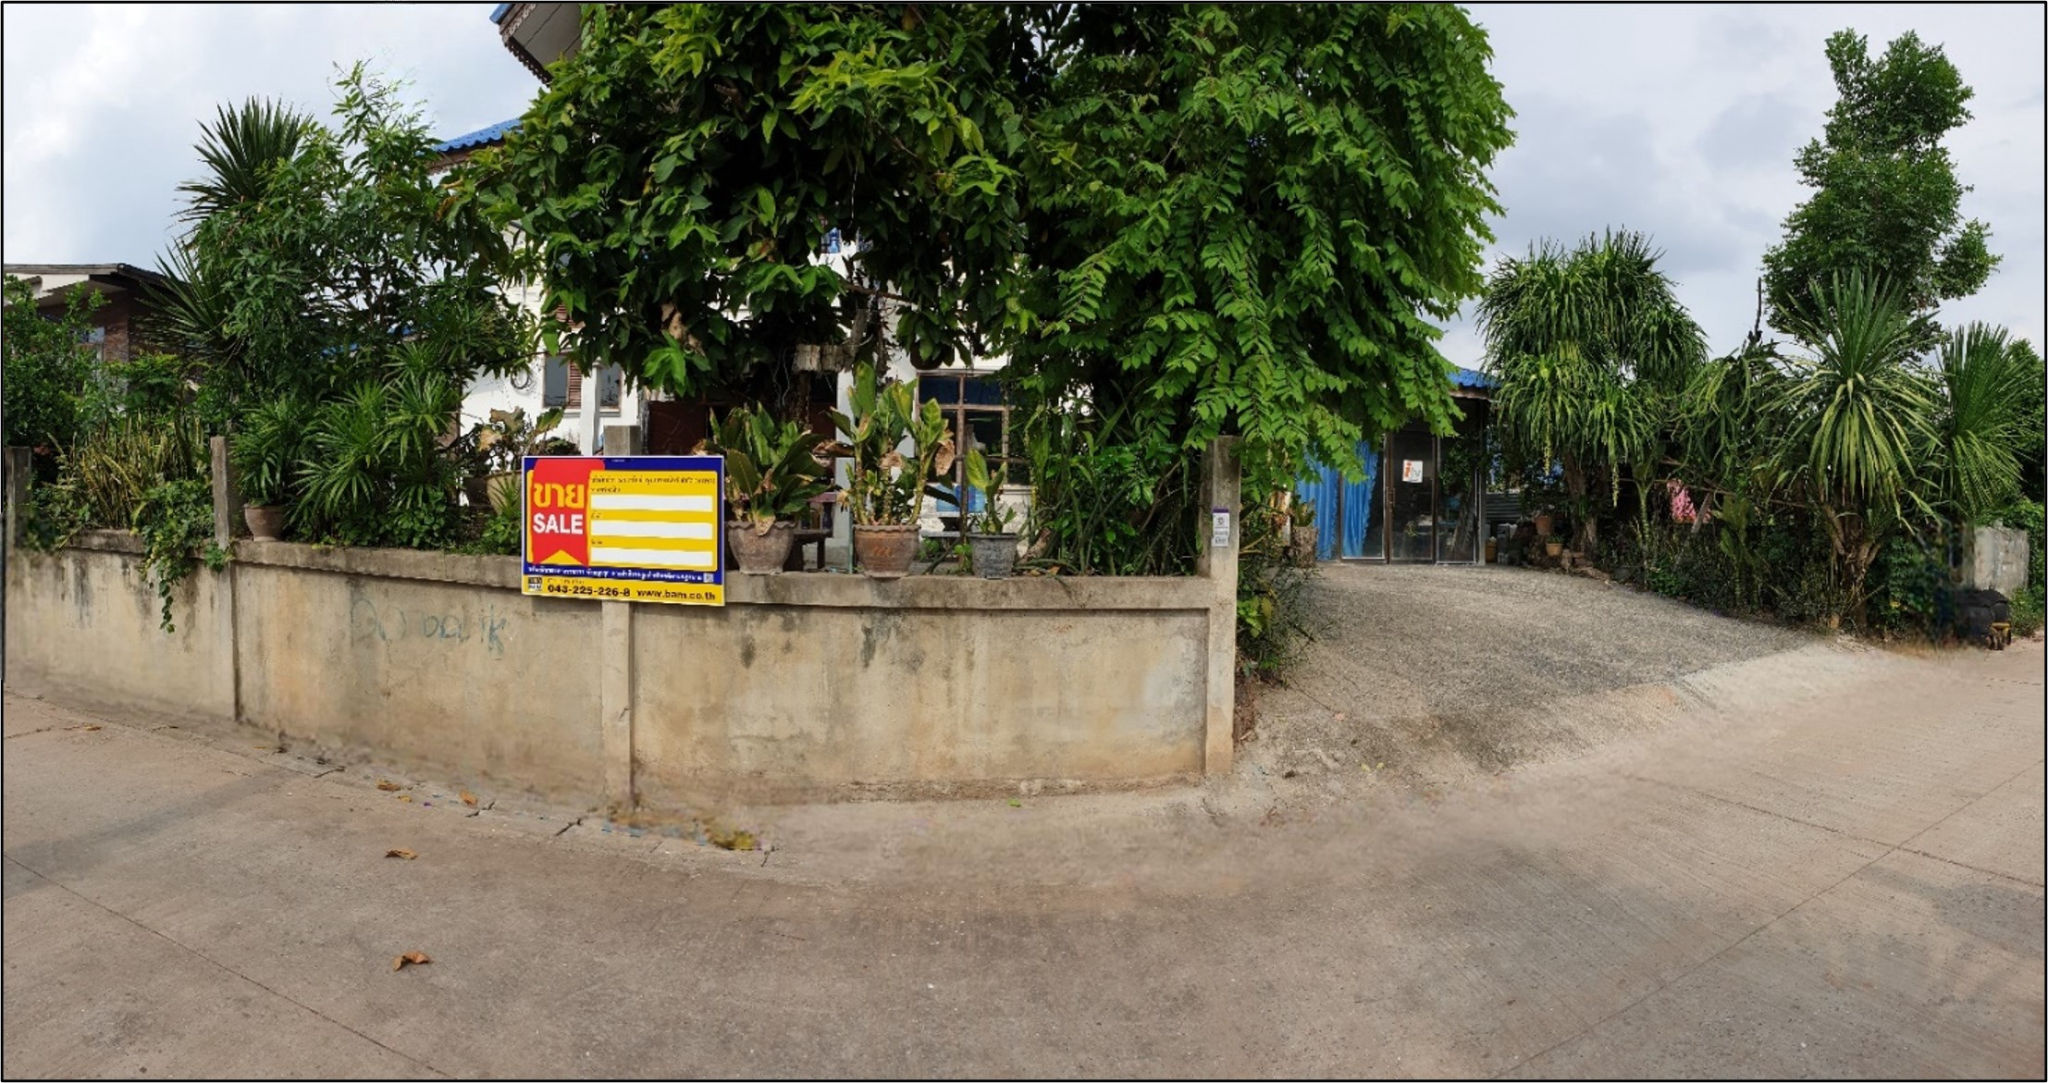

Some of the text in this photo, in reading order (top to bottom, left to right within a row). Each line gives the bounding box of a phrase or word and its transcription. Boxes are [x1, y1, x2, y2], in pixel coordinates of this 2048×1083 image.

[532, 482, 585, 509] ขาย
[532, 512, 584, 535] SALE
[547, 584, 716, 601] 043-225-226-8 www.bam.co.th
